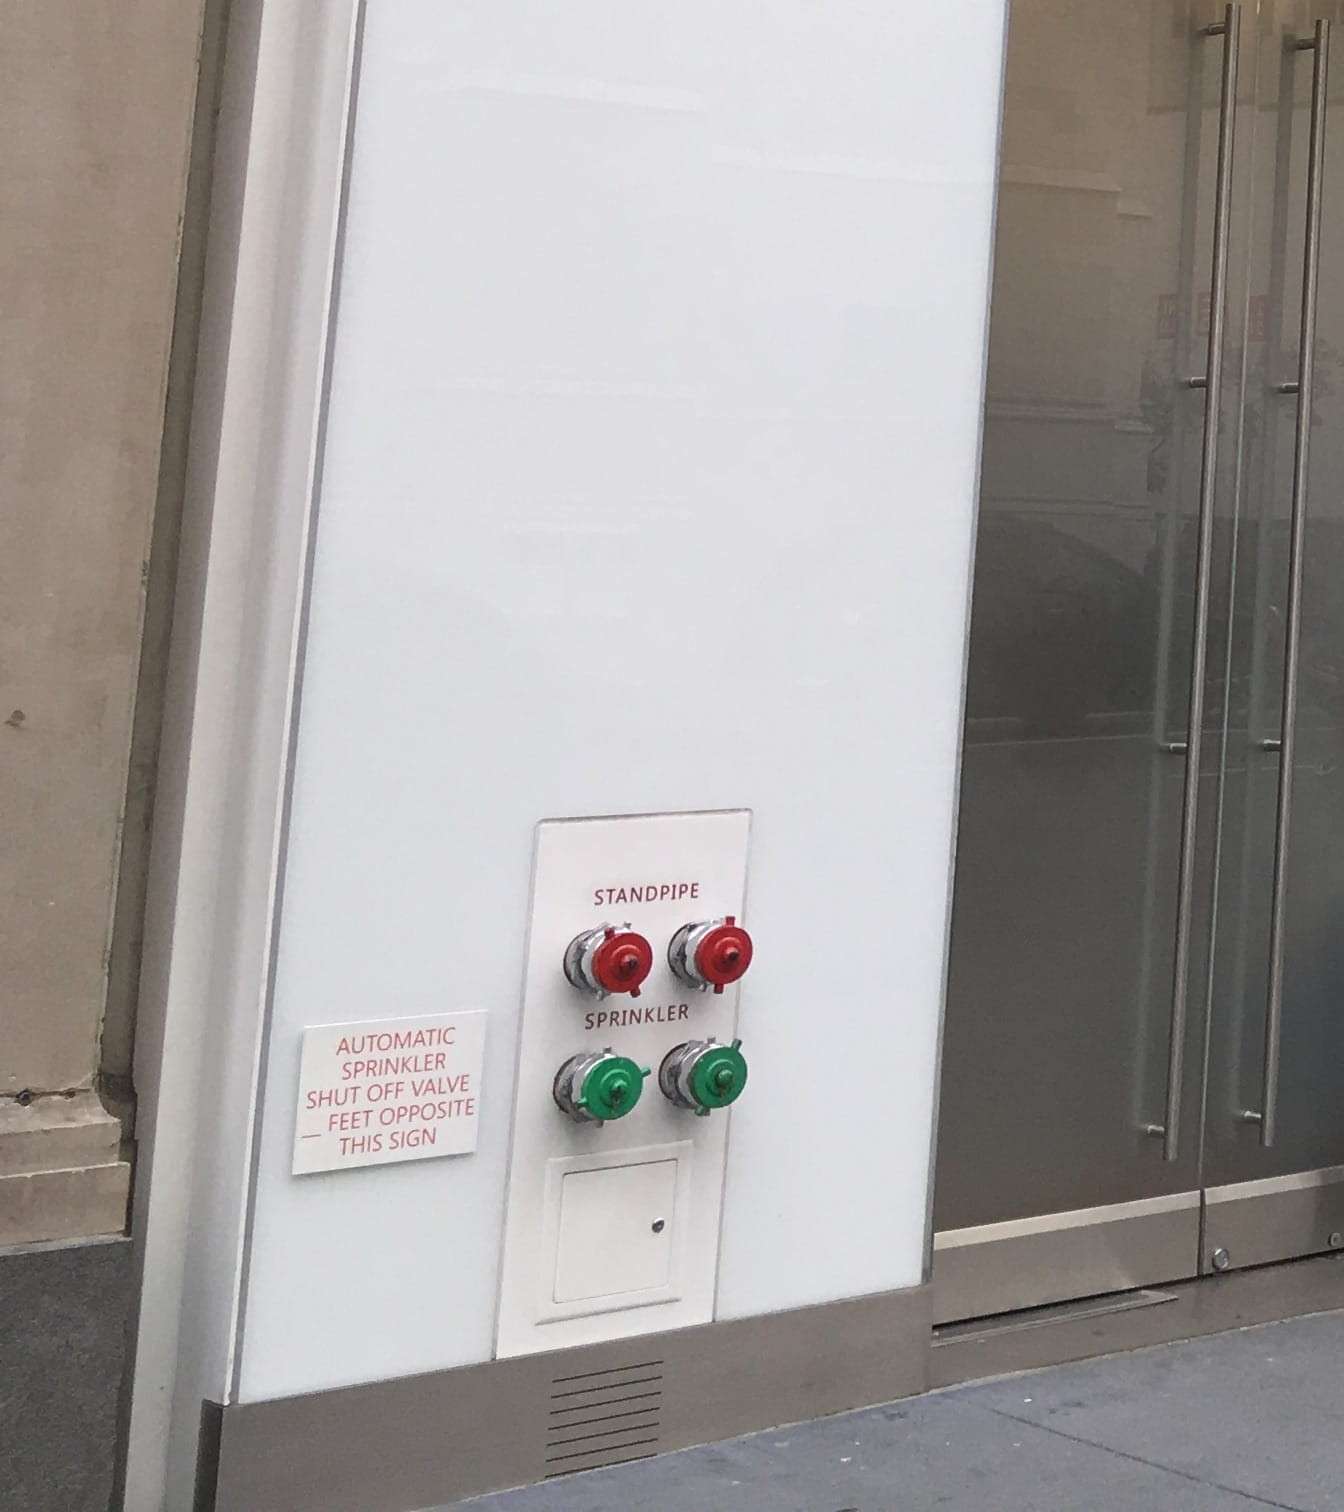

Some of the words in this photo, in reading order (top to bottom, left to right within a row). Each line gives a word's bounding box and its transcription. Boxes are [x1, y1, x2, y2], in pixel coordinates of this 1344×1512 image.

[594, 883, 699, 905] STANDPIPE
[585, 1004, 688, 1029] SPRINKLER
[336, 1027, 456, 1055] AUTOMATIC
[342, 1053, 446, 1080] SPRINKLER
[306, 1087, 361, 1109] SHUT
[367, 1081, 405, 1102] OFF
[411, 1074, 470, 1097] VALVE
[328, 1110, 374, 1131] FEET
[379, 1098, 475, 1126] OPPOSITE
[340, 1134, 383, 1155] THIS
[389, 1128, 437, 1150] SIGN
